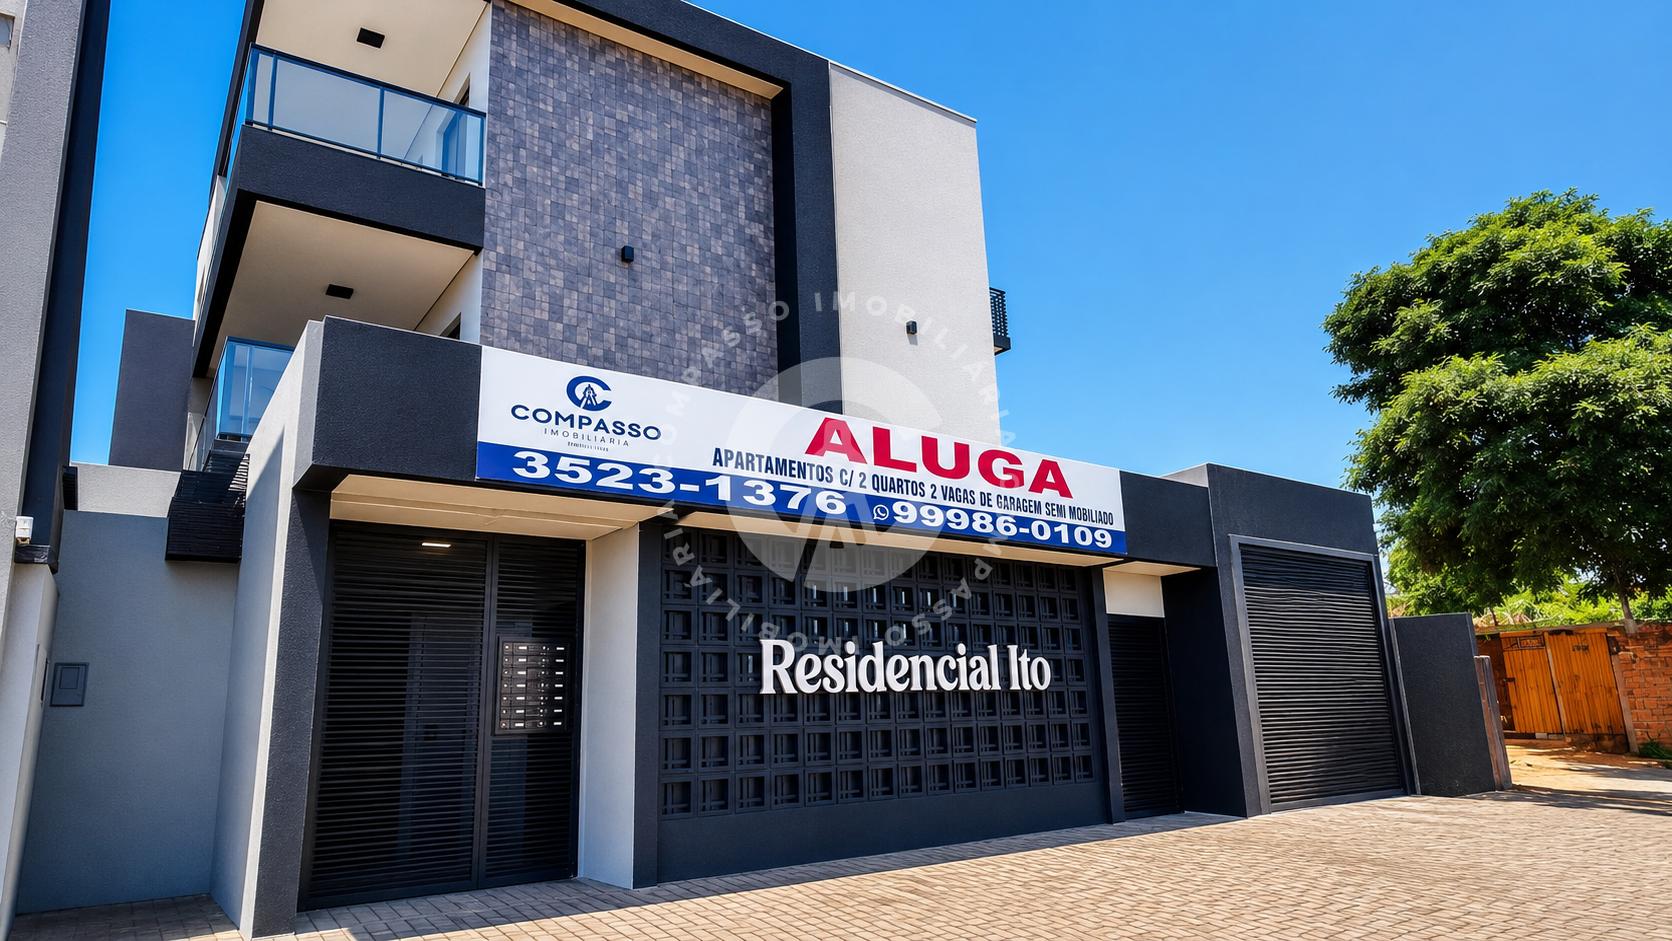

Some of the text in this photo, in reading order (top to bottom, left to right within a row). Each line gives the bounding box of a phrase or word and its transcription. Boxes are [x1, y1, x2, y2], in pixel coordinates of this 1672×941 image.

[511, 405, 661, 440] COMPASSO
[544, 428, 629, 446] IMOBILIARIA
[512, 450, 847, 515] 3523-1376
[805, 417, 1074, 499] ALUGA
[713, 447, 1114, 526] APARTAMENTOS C/ 2 QUARTOS 2 VAGAS DE GARAGEM SEMI MOBILIADO
[892, 501, 1113, 549] 99986-0109
[759, 639, 1051, 695] Residencial Ito
